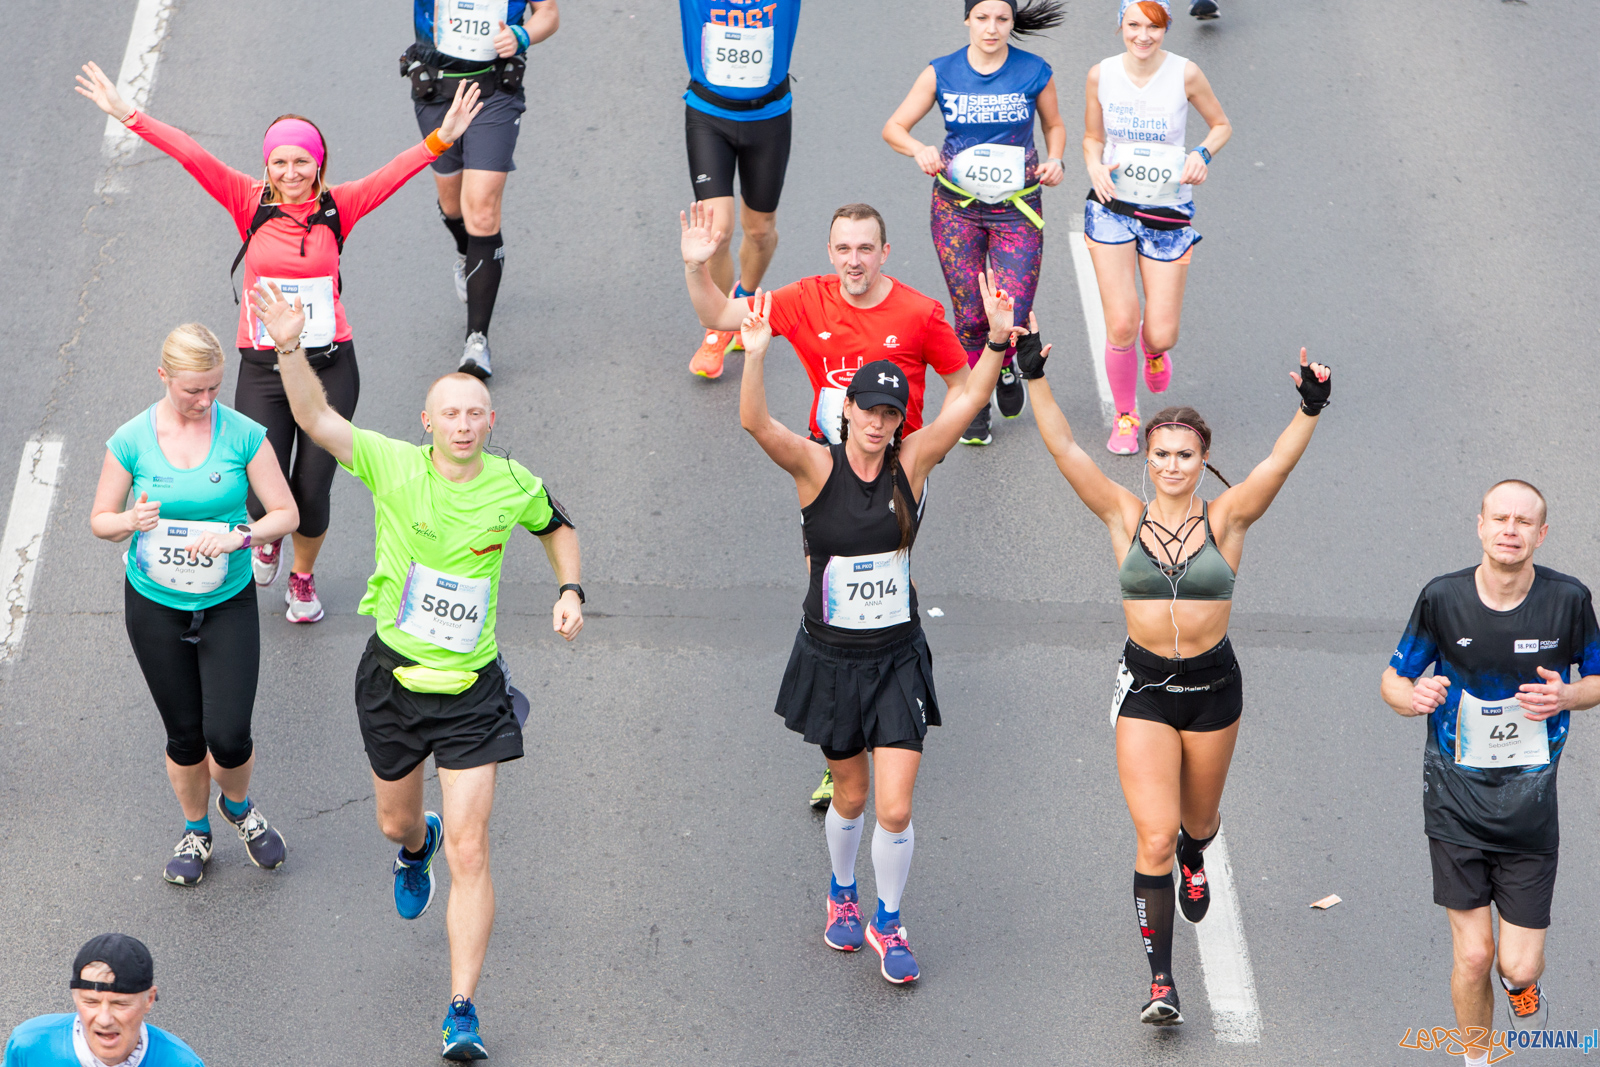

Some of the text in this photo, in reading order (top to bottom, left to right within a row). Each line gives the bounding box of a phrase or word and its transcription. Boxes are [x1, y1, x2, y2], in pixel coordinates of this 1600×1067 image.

[453, 18, 490, 36] 2118
[716, 47, 763, 64] 5880
[968, 93, 1028, 105] SIEBIEGA
[967, 108, 1029, 124] KIELECKI
[1132, 117, 1168, 130] Bartek
[1127, 128, 1166, 142] biegać
[965, 165, 1013, 183] 4502
[1124, 164, 1172, 184] 6809
[846, 578, 898, 601] 7014
[421, 593, 478, 623] 5804
[433, 616, 462, 629] Krzysztof
[1489, 722, 1519, 742] 42
[1488, 739, 1522, 749] Sebastian
[1136, 896, 1154, 954] IRONMAN
